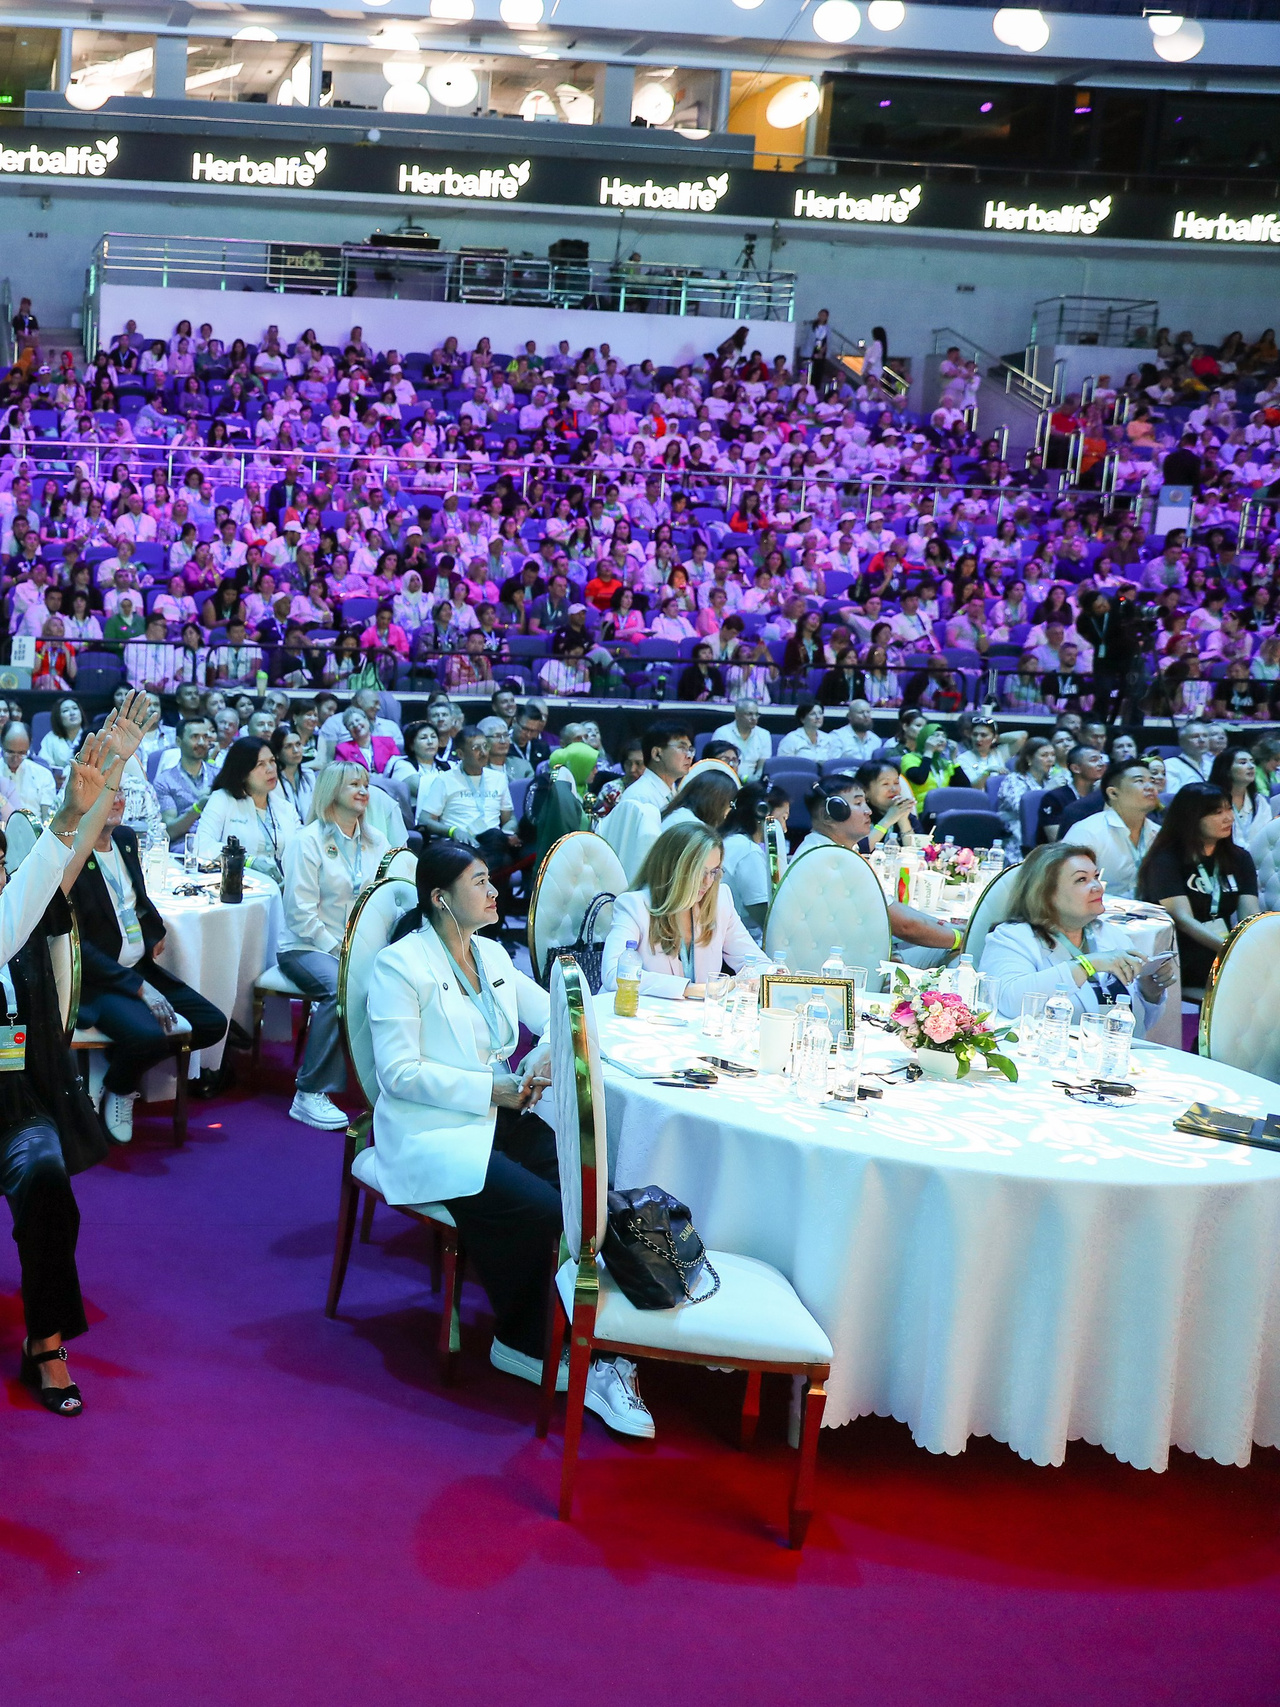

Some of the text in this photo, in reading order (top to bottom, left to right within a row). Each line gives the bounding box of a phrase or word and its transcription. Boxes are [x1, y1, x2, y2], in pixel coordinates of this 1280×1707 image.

[193, 153, 316, 187] Herbalife
[399, 166, 519, 200] Herbalife
[599, 177, 717, 212] Herbalife
[794, 189, 910, 224] Herbalife
[984, 201, 1100, 235] Herbalife
